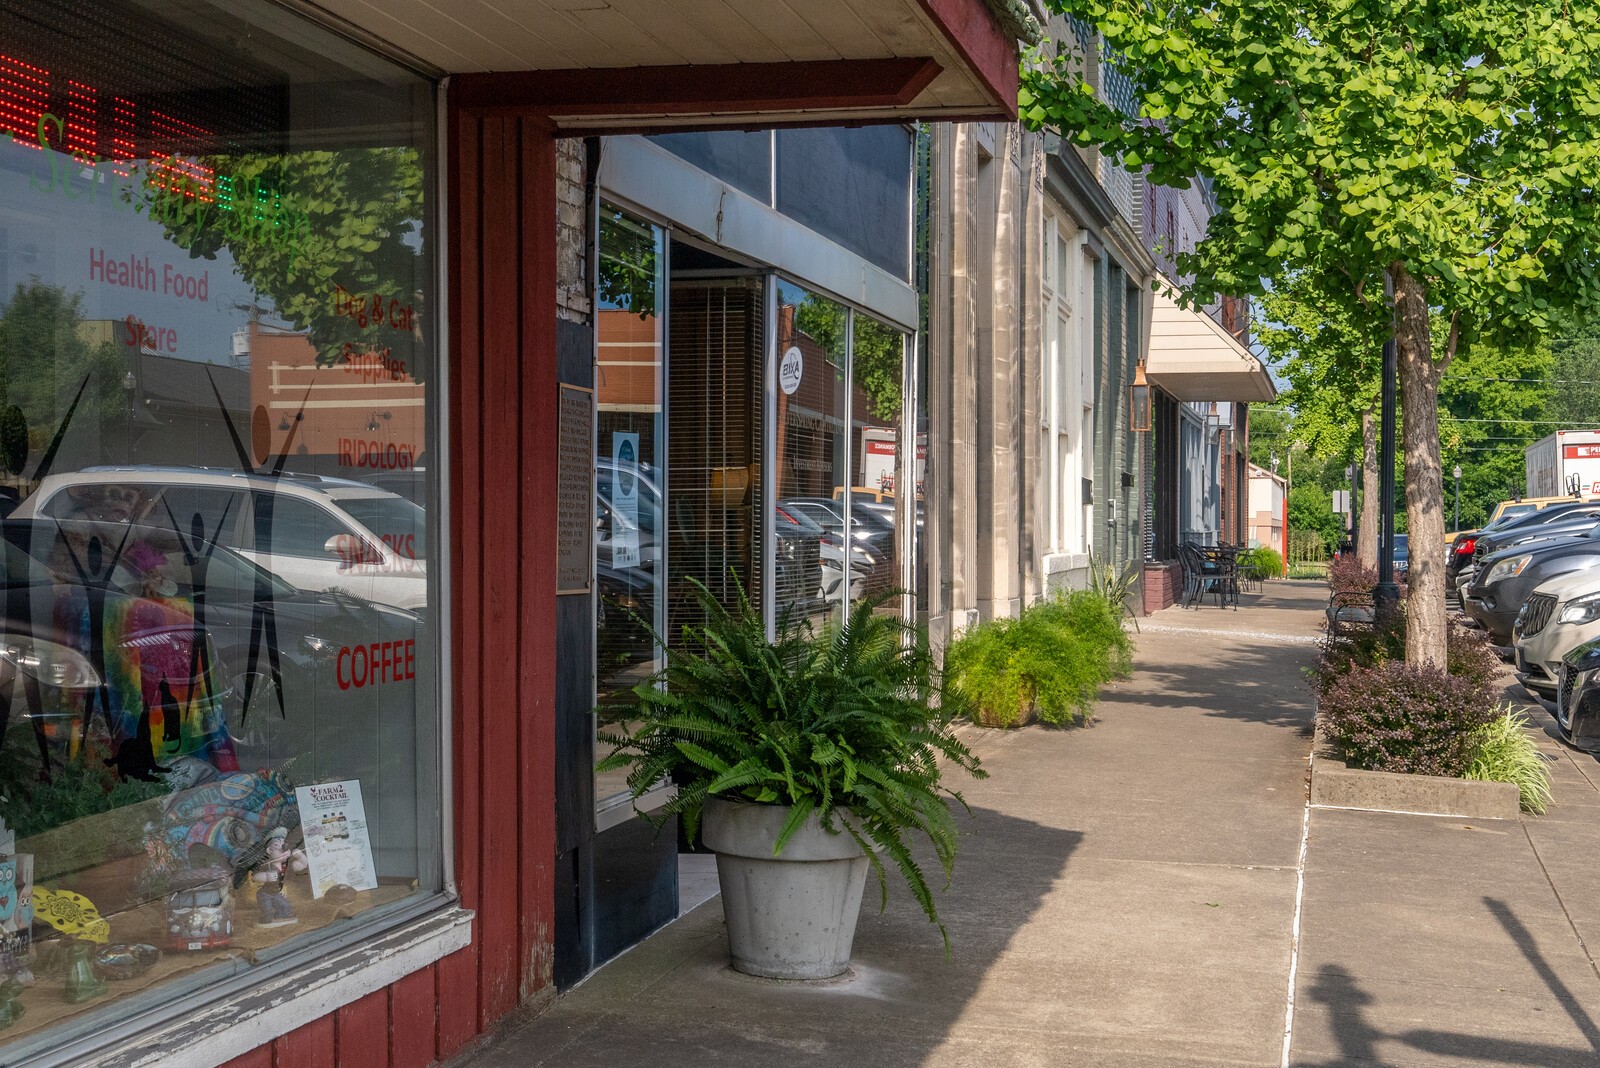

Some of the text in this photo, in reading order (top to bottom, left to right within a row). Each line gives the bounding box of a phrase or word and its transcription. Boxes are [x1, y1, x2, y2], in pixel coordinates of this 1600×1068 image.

[90, 247, 208, 302] Health Food
[336, 284, 415, 332] Dog & Cat
[125, 314, 177, 352] Store
[343, 342, 407, 384] Supplies
[338, 438, 417, 471] IRIDOLOGY
[336, 533, 416, 576] SNACKS
[336, 639, 415, 691] COFFEE
[316, 793, 347, 802] COCKTAIL
